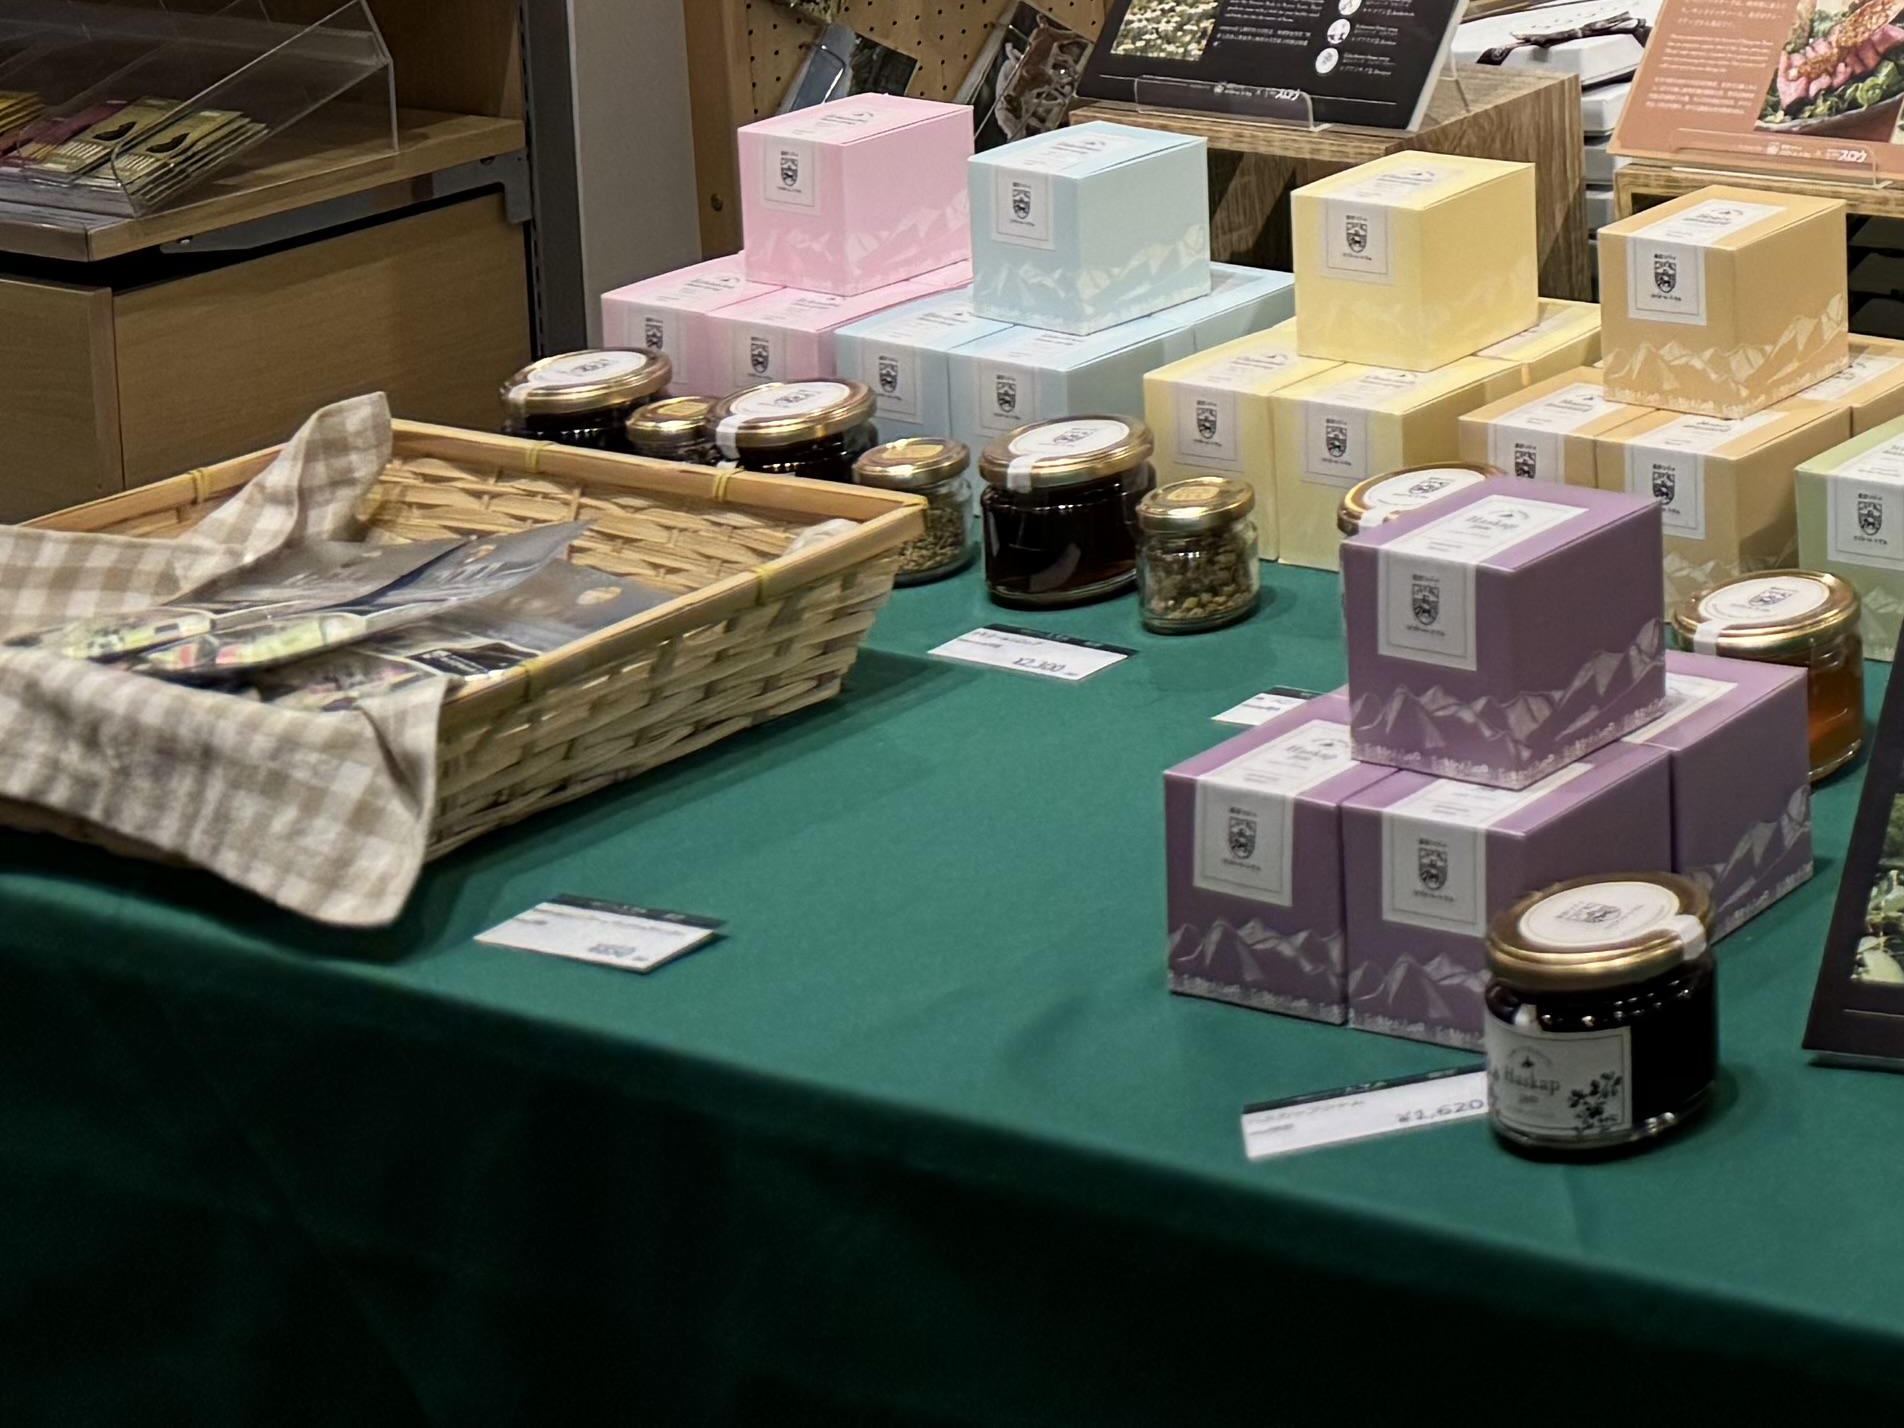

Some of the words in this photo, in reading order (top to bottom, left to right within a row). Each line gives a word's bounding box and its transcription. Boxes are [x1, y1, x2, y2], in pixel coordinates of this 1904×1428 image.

[1837, 149, 1868, 162] スロウ
[1504, 1070, 1561, 1096] Haskap
